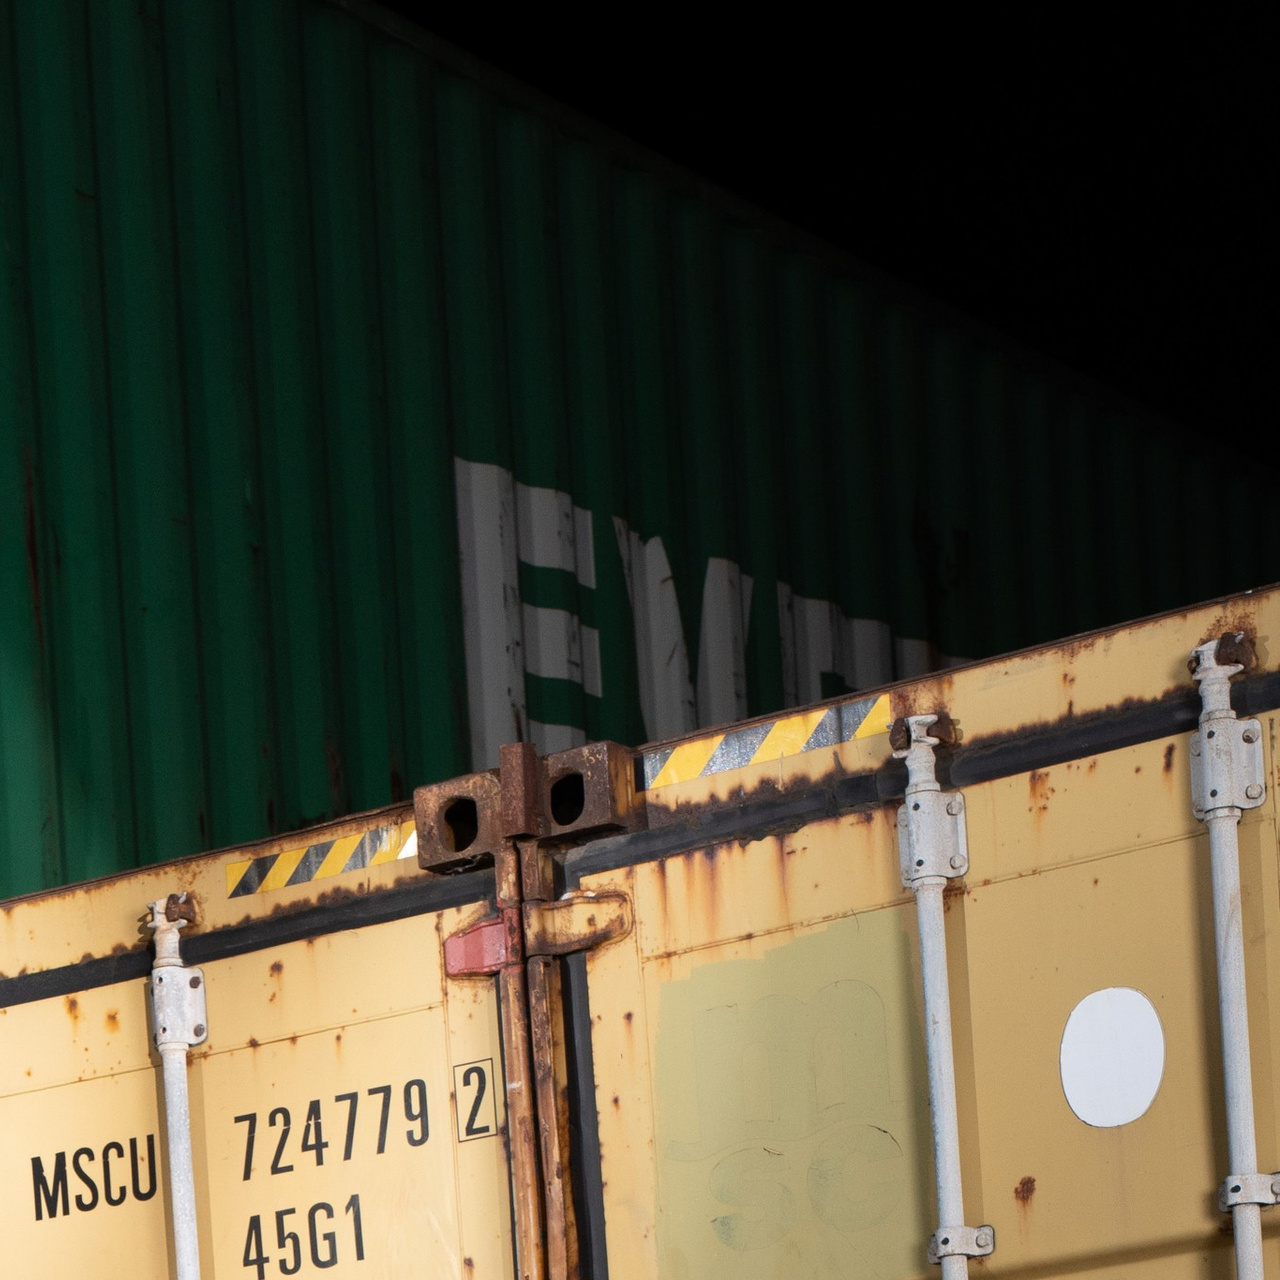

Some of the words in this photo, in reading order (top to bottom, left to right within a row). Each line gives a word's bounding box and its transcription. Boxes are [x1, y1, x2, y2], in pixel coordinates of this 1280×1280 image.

[30, 1133, 158, 1222] MSCU
[234, 1078, 430, 1182] 724779
[462, 1065, 490, 1137] 2
